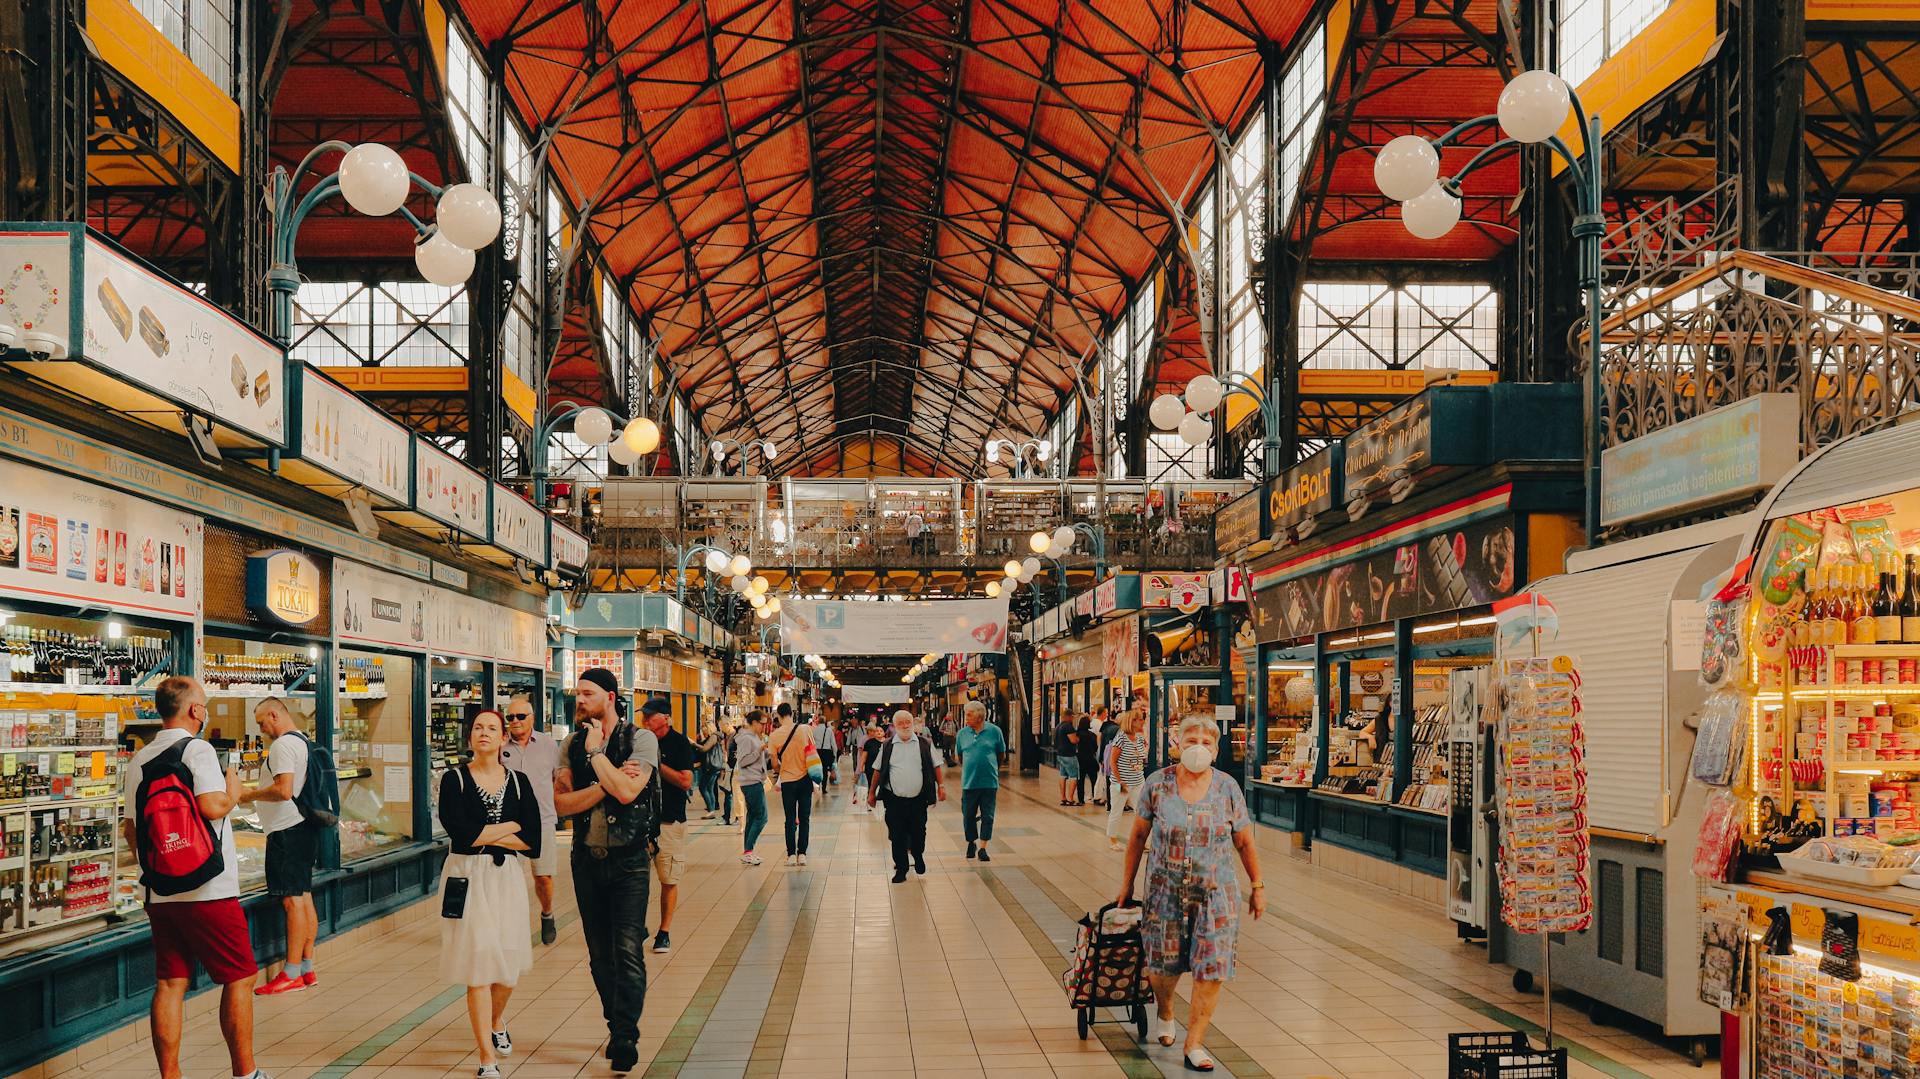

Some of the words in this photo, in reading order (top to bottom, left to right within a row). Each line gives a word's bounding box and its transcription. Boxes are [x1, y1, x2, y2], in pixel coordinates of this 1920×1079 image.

[190, 320, 213, 346] Liver
[12, 425, 29, 445] BT.
[56, 439, 75, 460] VAJ
[1345, 443, 1384, 475] Chocolate
[1388, 434, 1394, 455] &
[1398, 418, 1429, 449] Drinks
[1643, 475, 1689, 506] panaszok
[277, 584, 309, 619] TOKAJI
[377, 603, 401, 619] UNICUM
